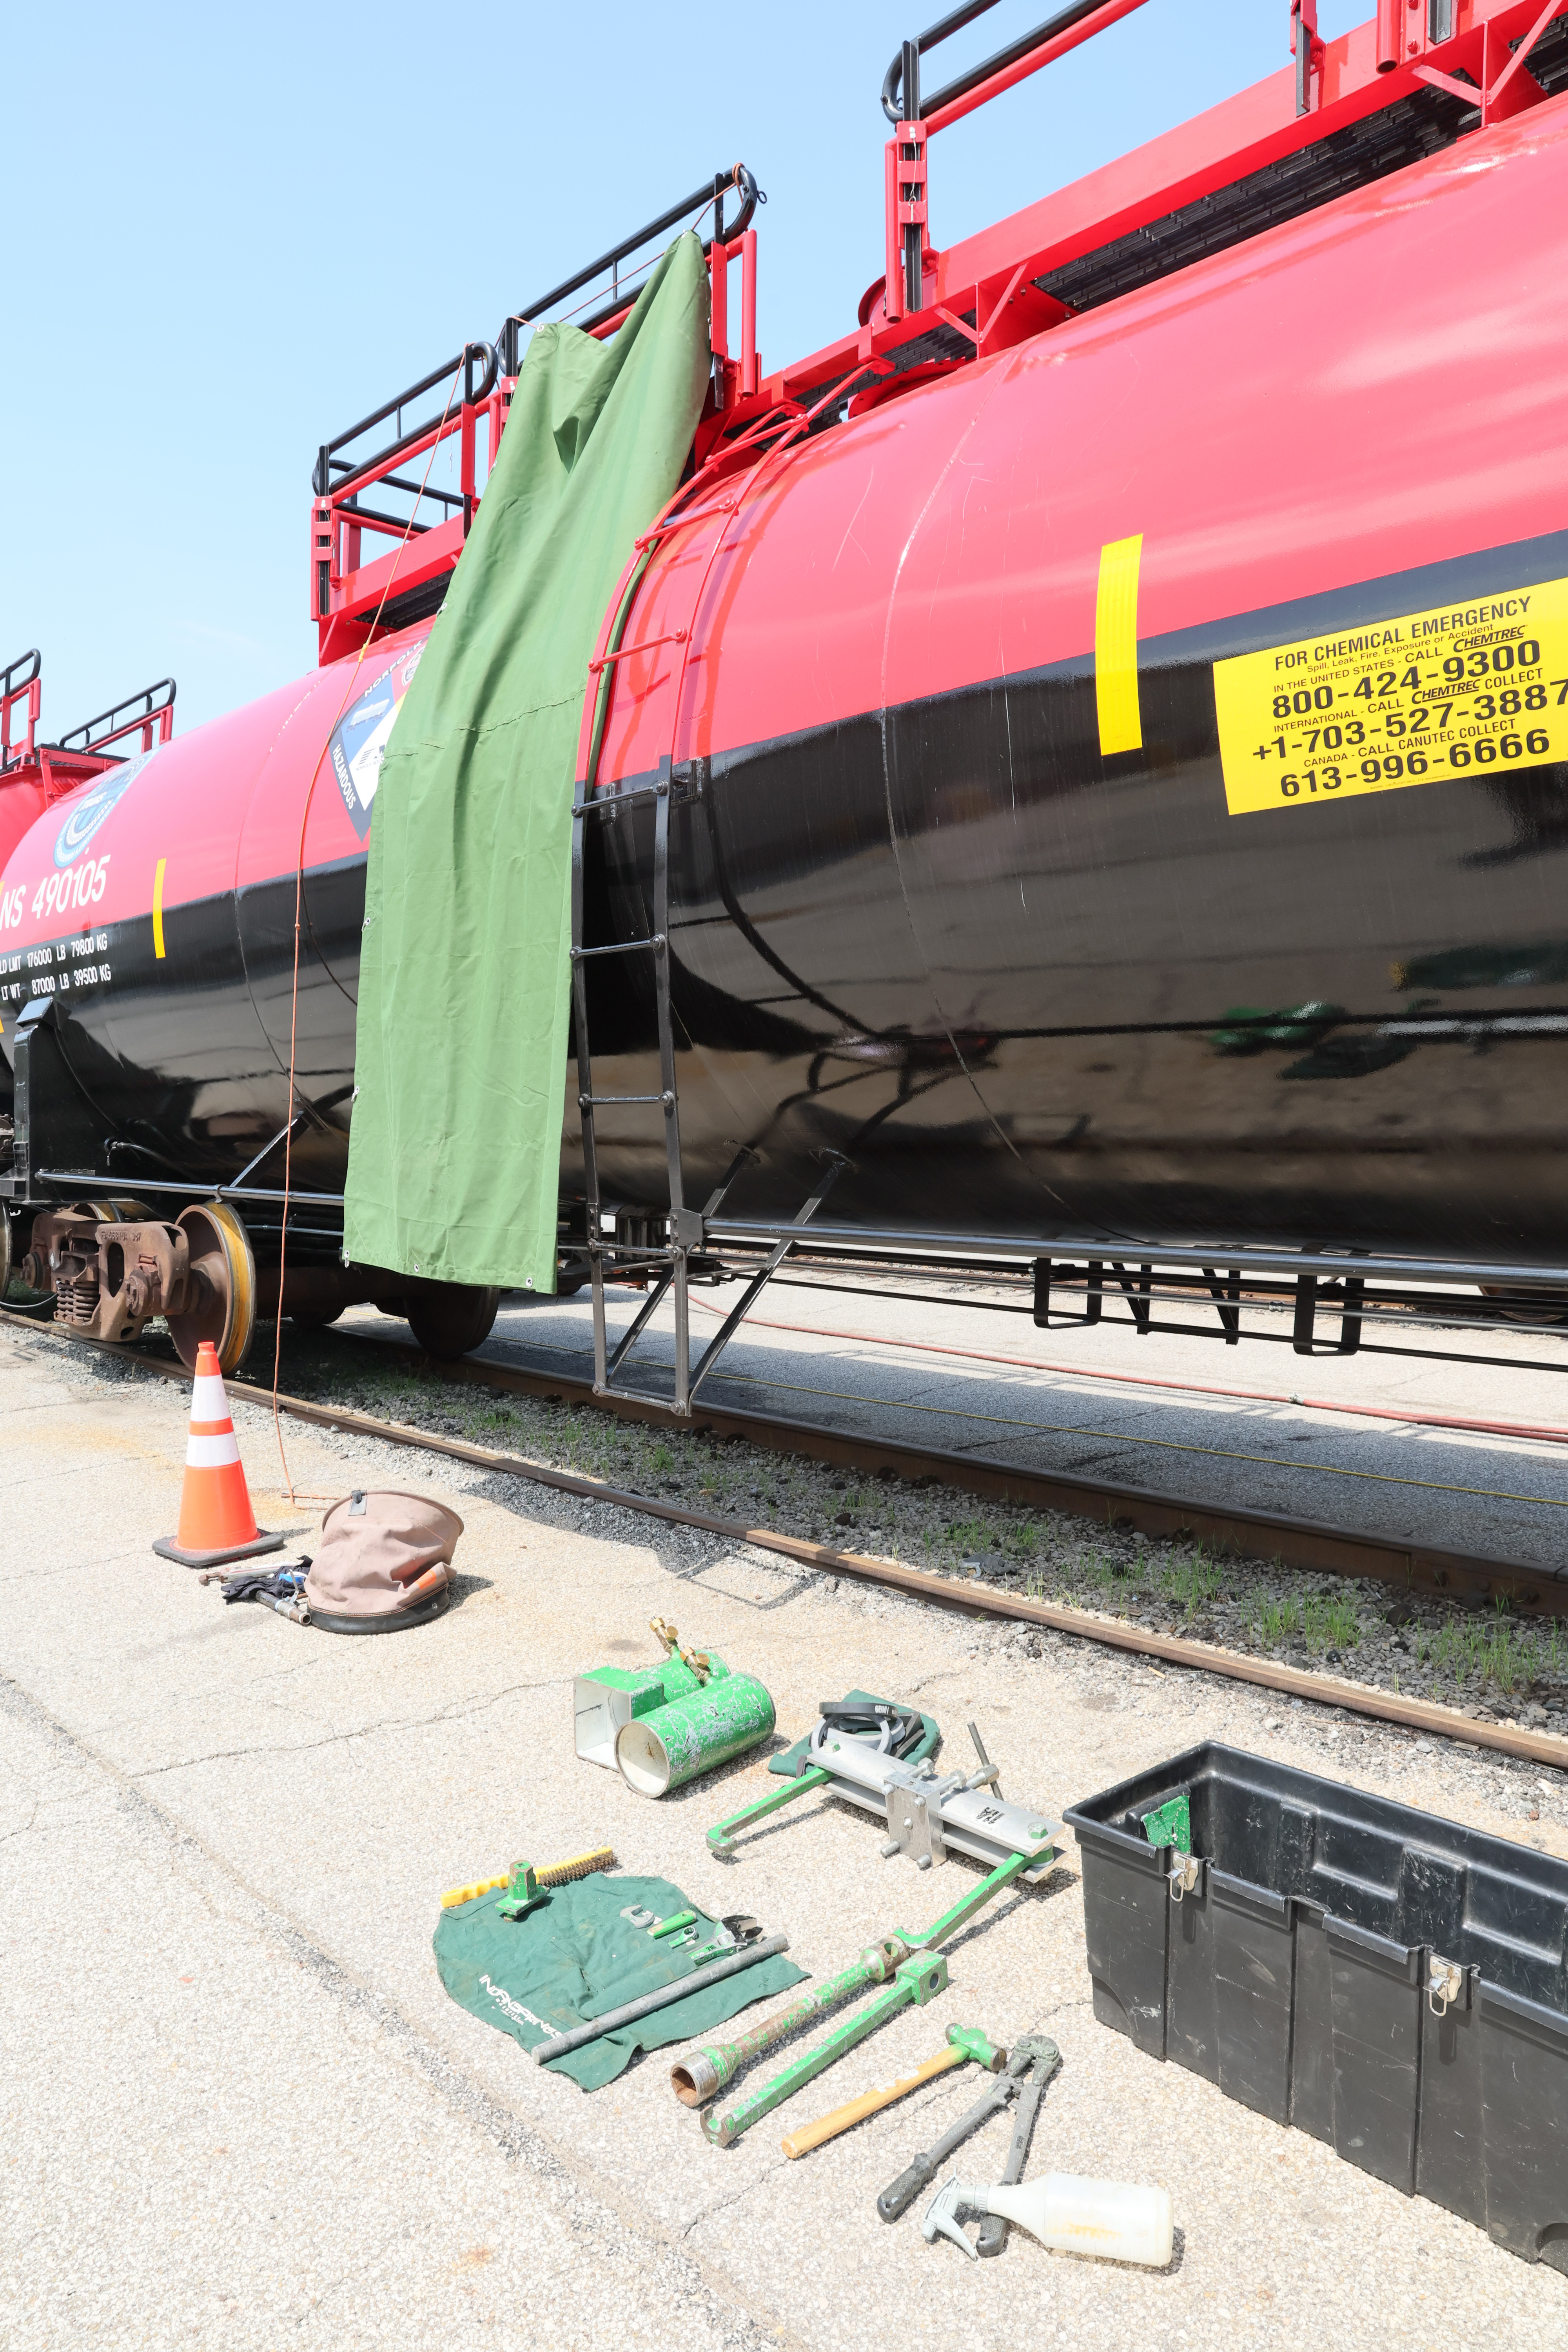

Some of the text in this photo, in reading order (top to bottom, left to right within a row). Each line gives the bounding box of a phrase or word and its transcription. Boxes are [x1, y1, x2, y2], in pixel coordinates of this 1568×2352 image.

[1275, 596, 1530, 671] FOR CHEMICAL EMERGENCY
[1307, 662, 1329, 673] Spill,
[1332, 656, 1357, 667] Leak,
[1361, 651, 1381, 661] Fire,
[1384, 639, 1431, 654] Exposure
[1448, 624, 1494, 640] Accident
[365, 640, 422, 697] NORFOLK
[1272, 640, 1540, 718] 800-424-9300
[1274, 684, 1284, 693] IN
[1287, 679, 1307, 690] THE
[1310, 669, 1350, 684] UNITED
[1353, 659, 1394, 675] STATES
[1405, 647, 1443, 663] CALL
[1253, 678, 1568, 760] +1-703-527-3887
[1274, 710, 1357, 733] INTERNATIONAL
[1367, 698, 1405, 713] CALL
[1485, 668, 1543, 689] COLLECT
[1280, 728, 1550, 797] 613-996-6666
[1304, 753, 1348, 767] CANADA
[1358, 743, 1394, 757] CALL
[1398, 730, 1455, 750] CANUTEC
[1459, 718, 1515, 738] COLLECT
[332, 744, 356, 809] HAZARDOUS
[0, 854, 111, 931] NS 490105
[1, 963, 111, 1000] LT WT 87000 LB 39500 KG
[9, 955, 21, 972] LMT
[27, 947, 52, 968] 176000
[56, 944, 66, 961] LB
[71, 936, 94, 958] 79800
[96, 933, 108, 952] KG
[875, 1705, 889, 1714] 6BMV
